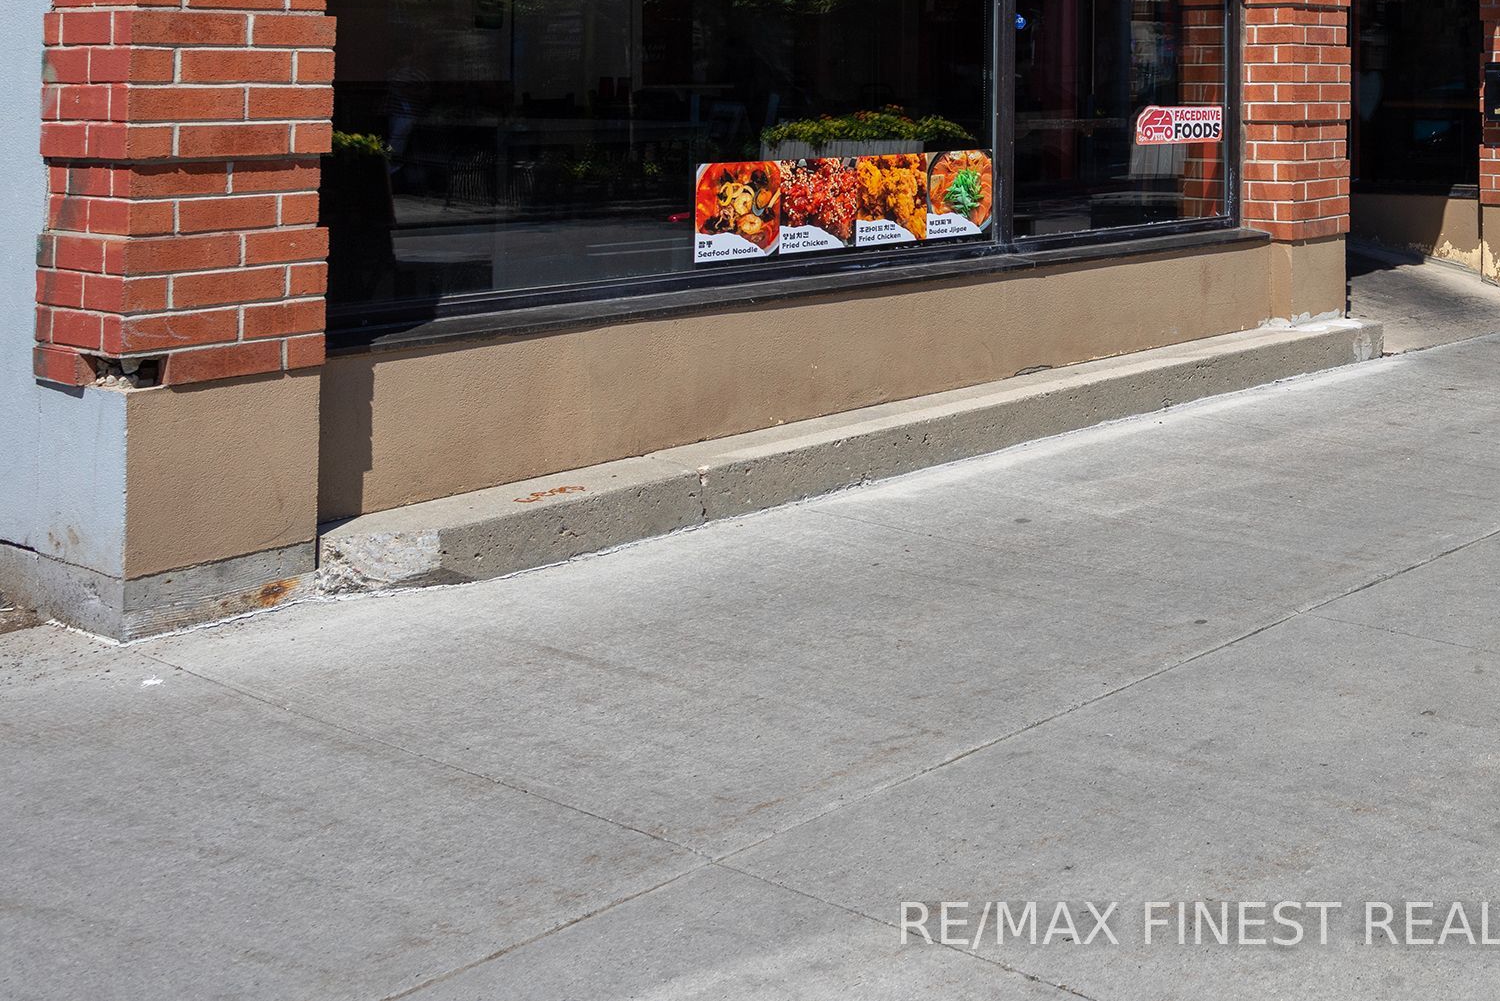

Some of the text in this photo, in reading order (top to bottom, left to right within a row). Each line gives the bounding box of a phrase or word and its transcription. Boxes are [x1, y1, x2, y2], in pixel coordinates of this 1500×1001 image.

[1174, 109, 1221, 121] FACEDRIVE
[1174, 122, 1220, 139] FOODS
[858, 232, 902, 242] Fried Chicken
[782, 238, 829, 250] Fried Chicken
[697, 245, 758, 258] Seafood Noodle
